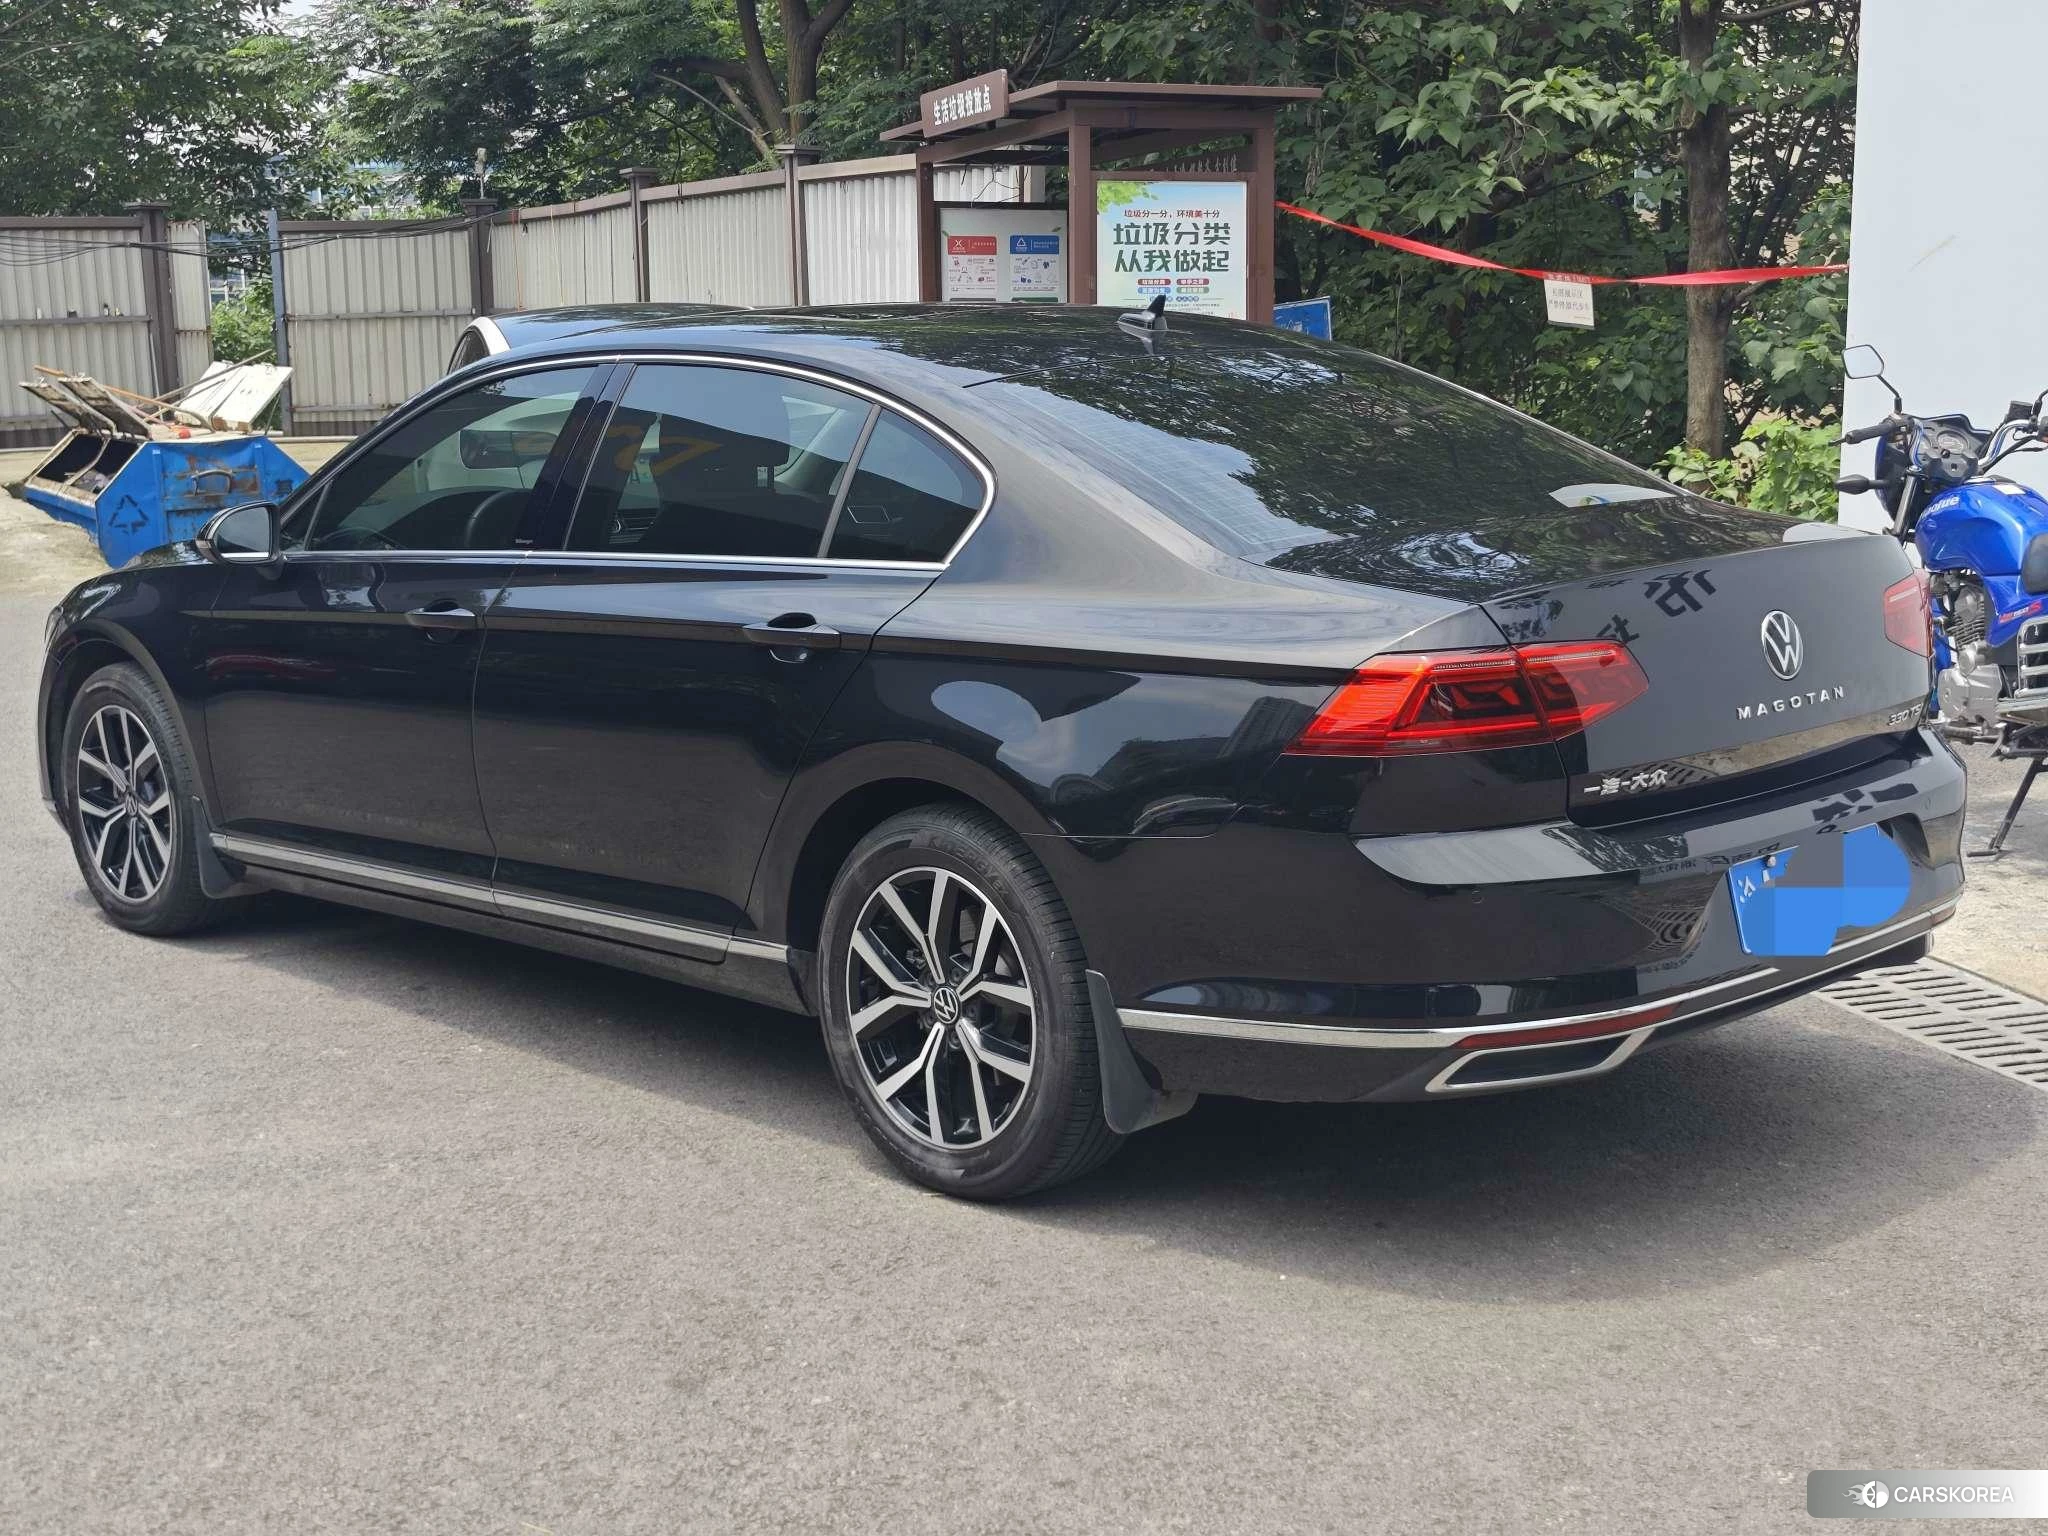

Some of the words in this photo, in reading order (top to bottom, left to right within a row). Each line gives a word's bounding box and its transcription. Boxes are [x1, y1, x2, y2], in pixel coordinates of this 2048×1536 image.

[933, 84, 991, 126] 生活垃圾投放点
[1113, 222, 1231, 246] 垃圾分类
[1114, 249, 1230, 272] 从我做起
[1737, 686, 1844, 720] MAGOTAN
